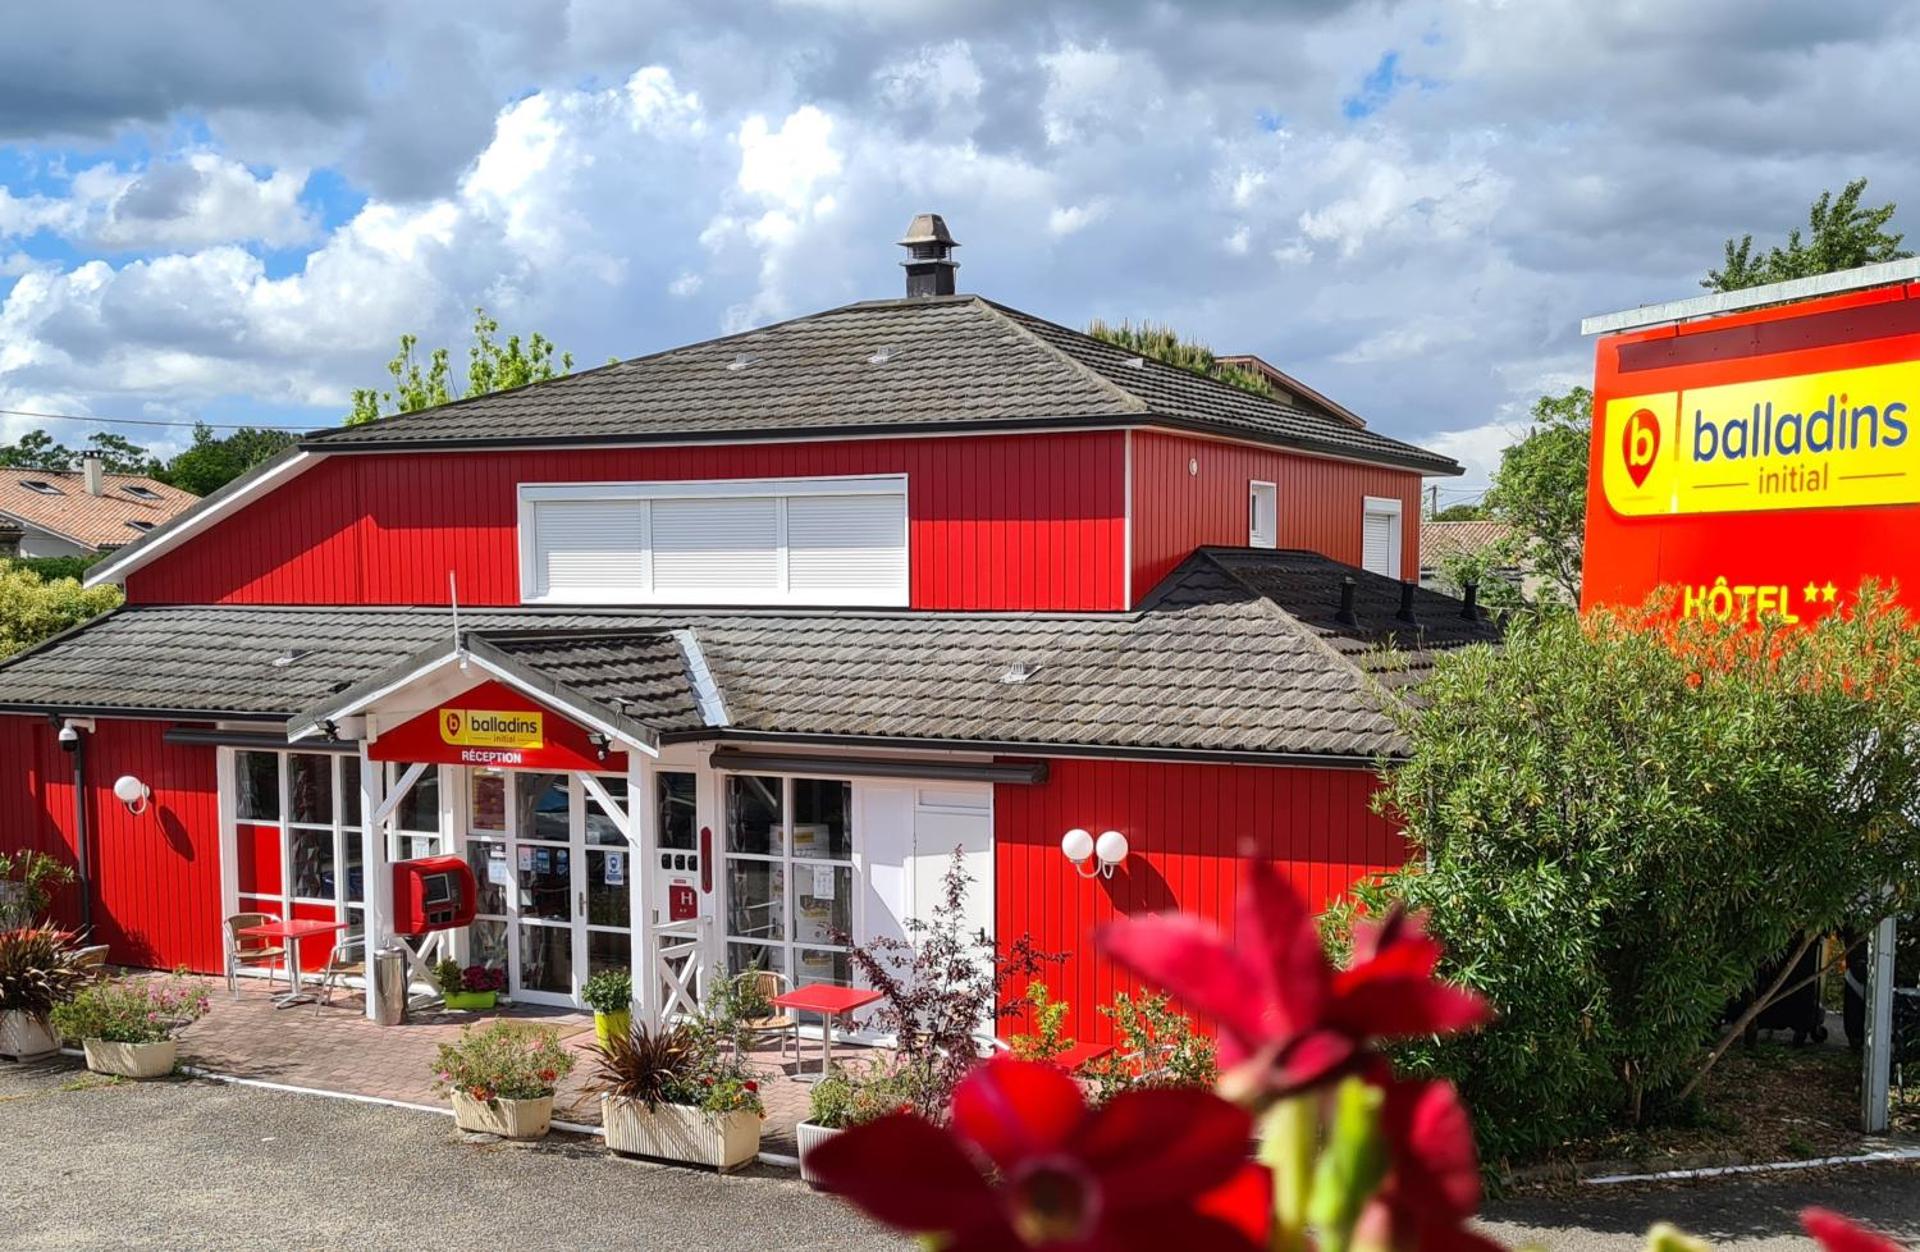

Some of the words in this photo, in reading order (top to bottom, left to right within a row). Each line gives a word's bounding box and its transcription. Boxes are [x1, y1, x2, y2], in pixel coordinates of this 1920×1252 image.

[1629, 416, 1655, 466] b
[1692, 393, 1909, 462] balladins
[1758, 462, 1829, 494] initial
[1684, 575, 1799, 624] HÔTEL
[471, 716, 537, 733] balladins
[493, 734, 516, 743] initial
[461, 748, 522, 763] RÉCEPTION
